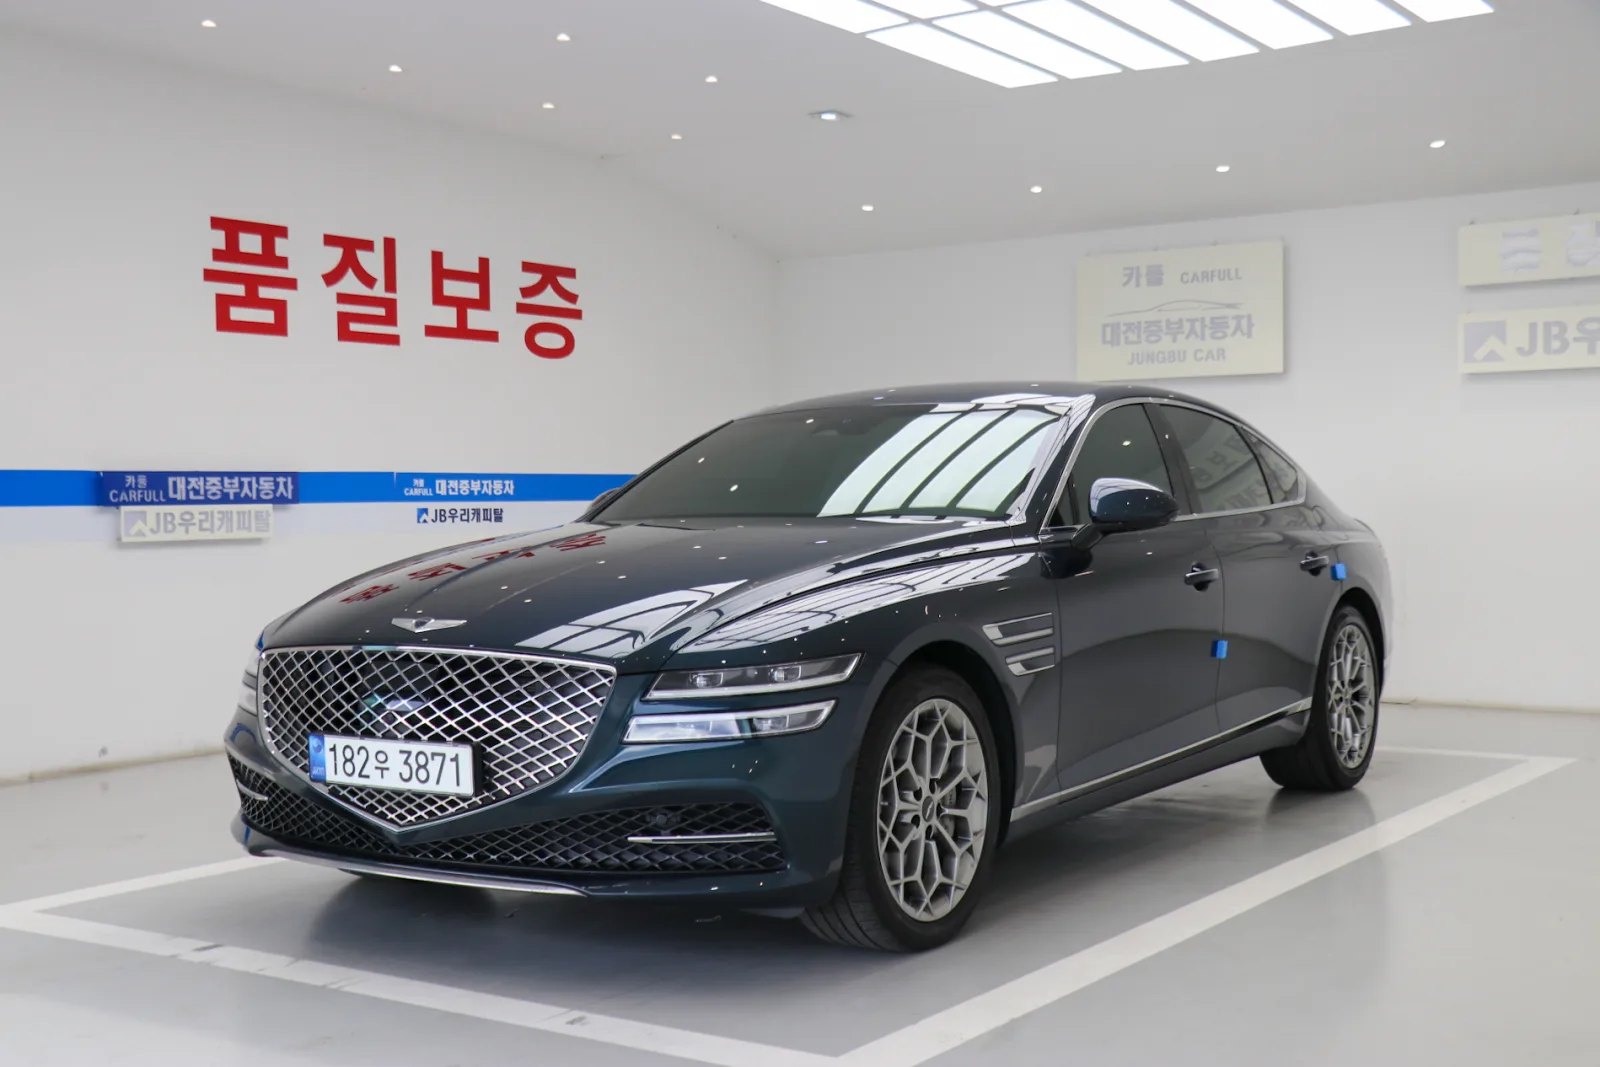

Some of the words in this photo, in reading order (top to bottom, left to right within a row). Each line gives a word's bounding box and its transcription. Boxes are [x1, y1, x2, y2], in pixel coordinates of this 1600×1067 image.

[1181, 268, 1243, 284] CARFULL
[203, 216, 582, 359] 품질보증
[1127, 350, 1187, 366] JUNGBU
[1193, 348, 1226, 362] CAR
[168, 476, 294, 500] 대전중부자동차
[404, 488, 433, 496] CARFULL
[435, 479, 515, 495] 대전중부자동차
[109, 490, 166, 502] CARFULL
[150, 509, 271, 535] JB우리캐피탈
[431, 508, 504, 523] JB우리캐피탈
[329, 744, 390, 779] 182우
[398, 749, 461, 787] 3871
